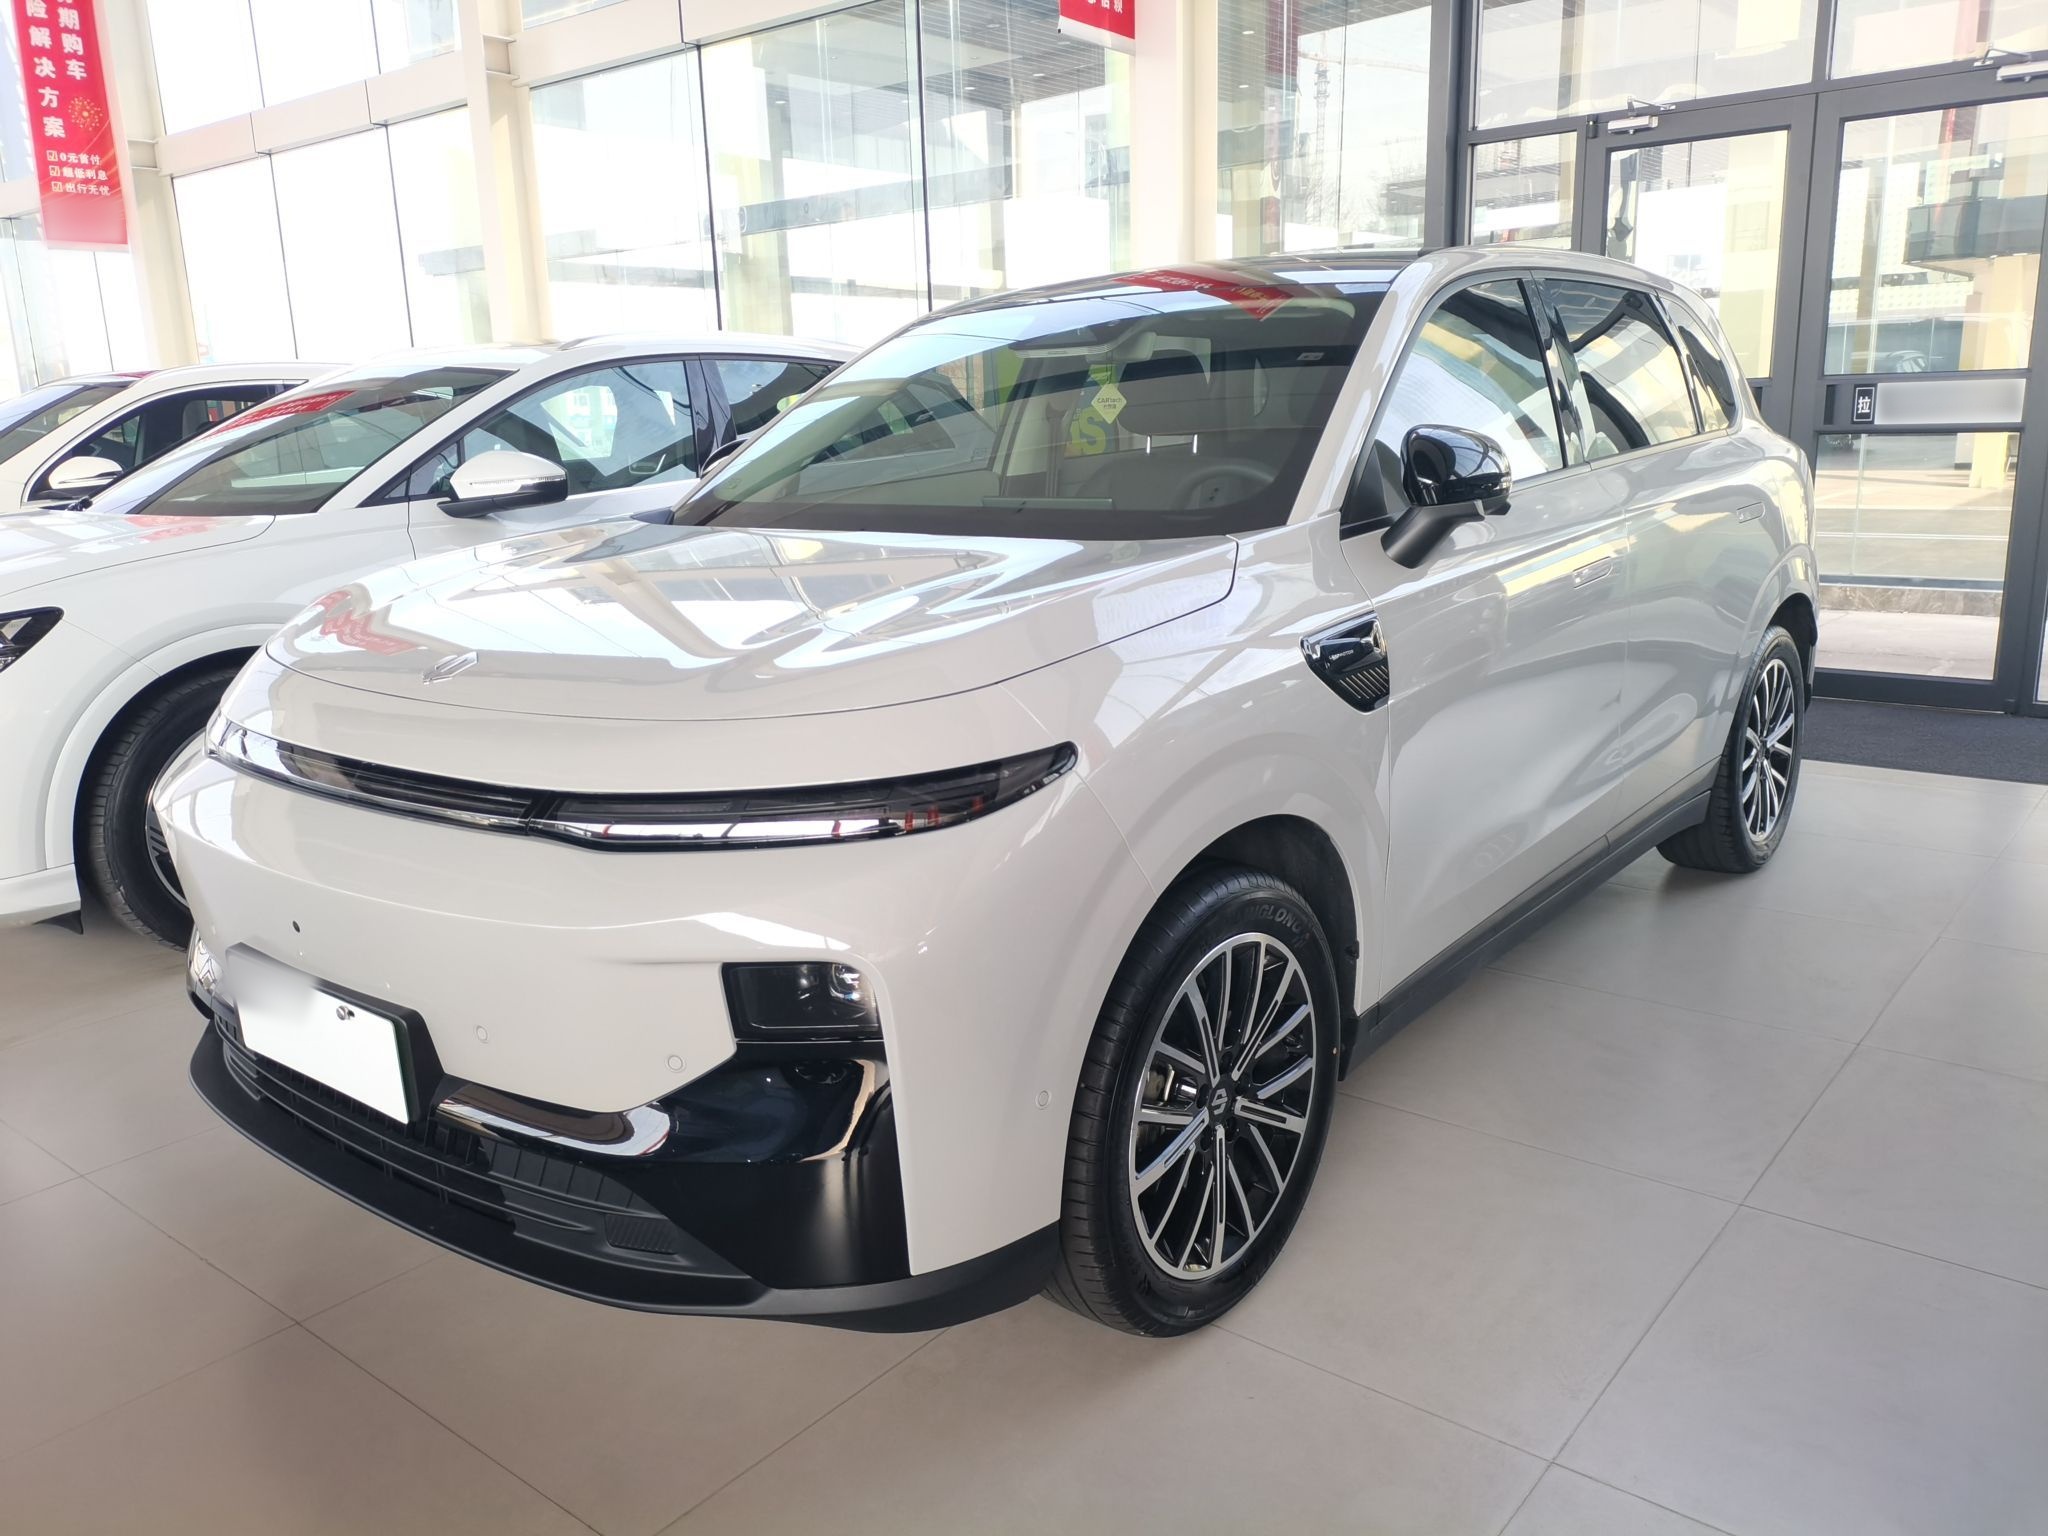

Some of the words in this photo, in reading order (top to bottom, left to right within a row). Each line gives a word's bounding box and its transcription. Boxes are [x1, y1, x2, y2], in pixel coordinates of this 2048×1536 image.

[57, 0, 87, 80] 期购车
[65, 182, 111, 196] 出行无忧
[1857, 396, 1871, 413] 拉
